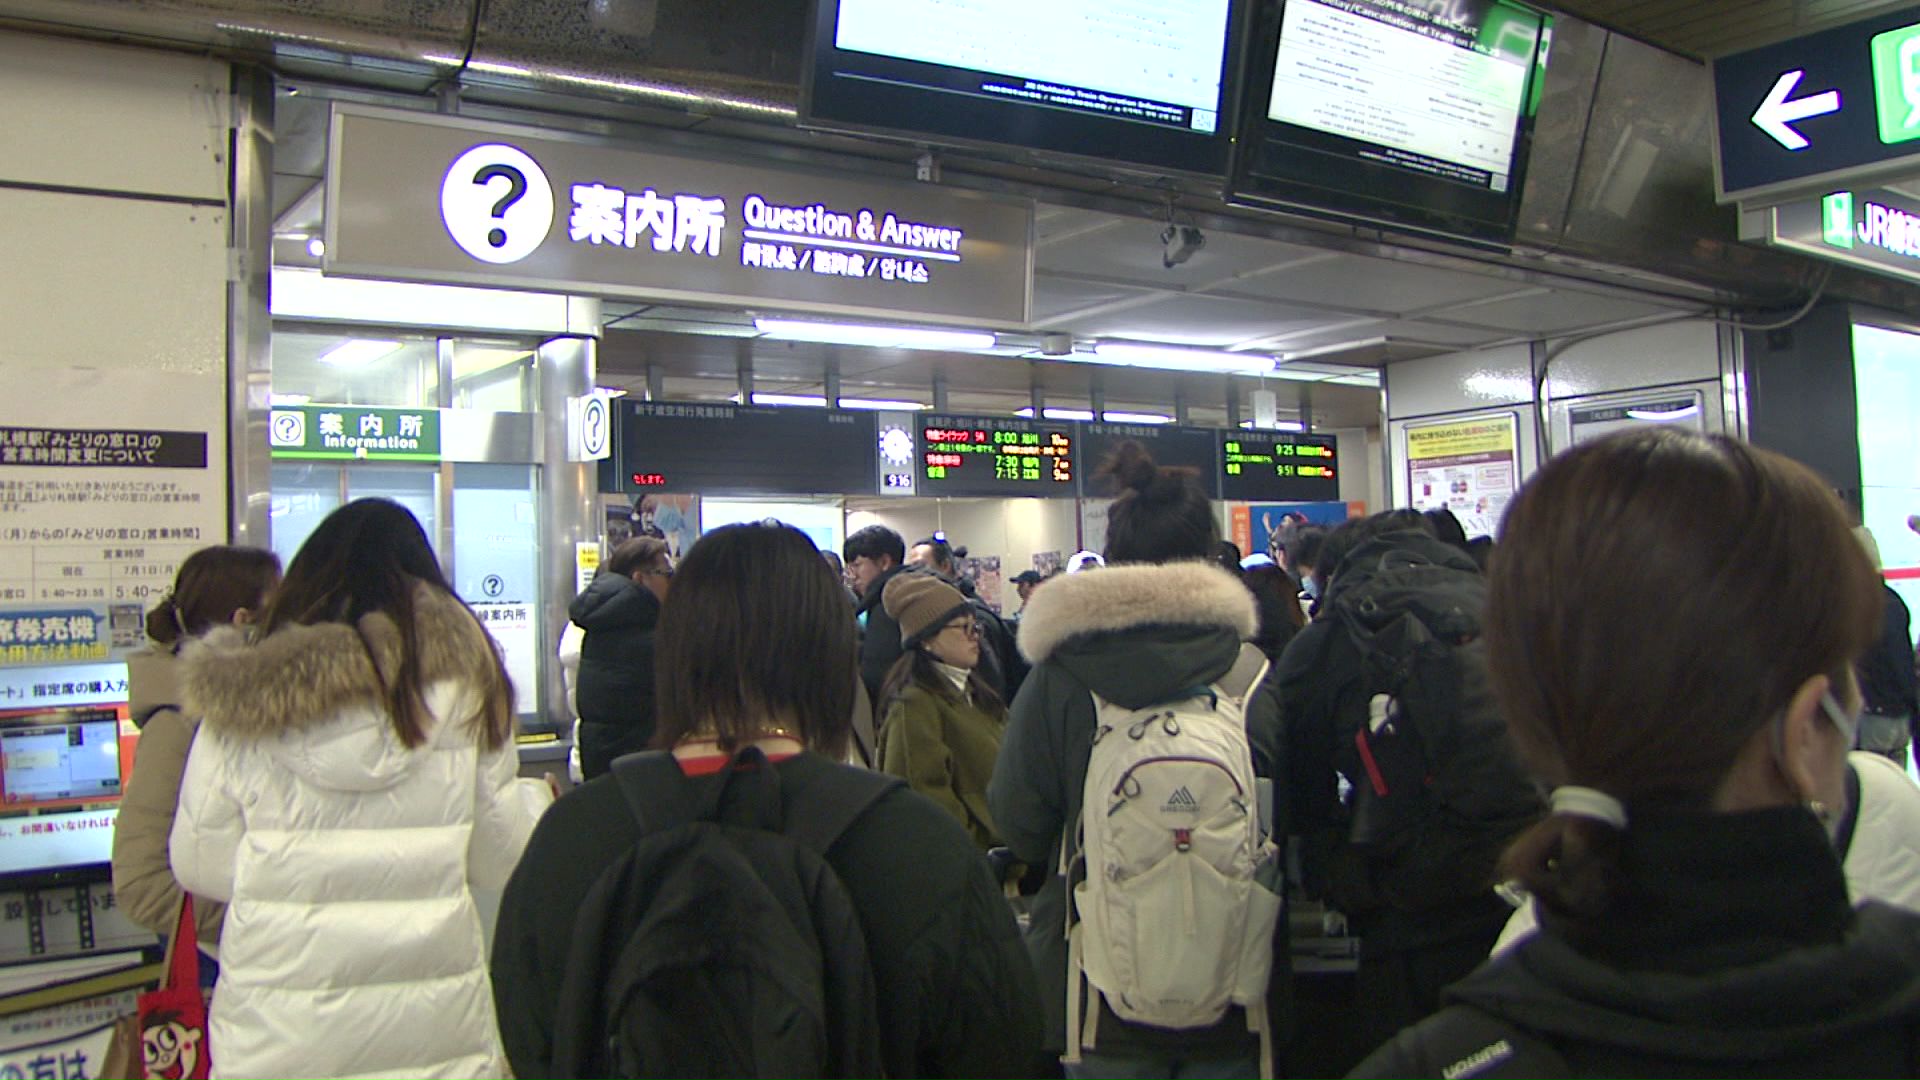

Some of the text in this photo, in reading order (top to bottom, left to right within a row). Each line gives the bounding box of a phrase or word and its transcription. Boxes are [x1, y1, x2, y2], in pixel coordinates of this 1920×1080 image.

[1430, 26, 1454, 43] Train
[569, 183, 725, 257] 案内所
[744, 196, 962, 250] Question & Answer
[320, 413, 423, 437] 案内所
[325, 434, 418, 449] Information
[994, 431, 1017, 444] 8:00
[3, 447, 156, 464] 営業時間変更について
[996, 455, 1018, 467] 7:30
[996, 467, 1018, 479] 7:15
[21, 817, 117, 834] お間違いなければ
